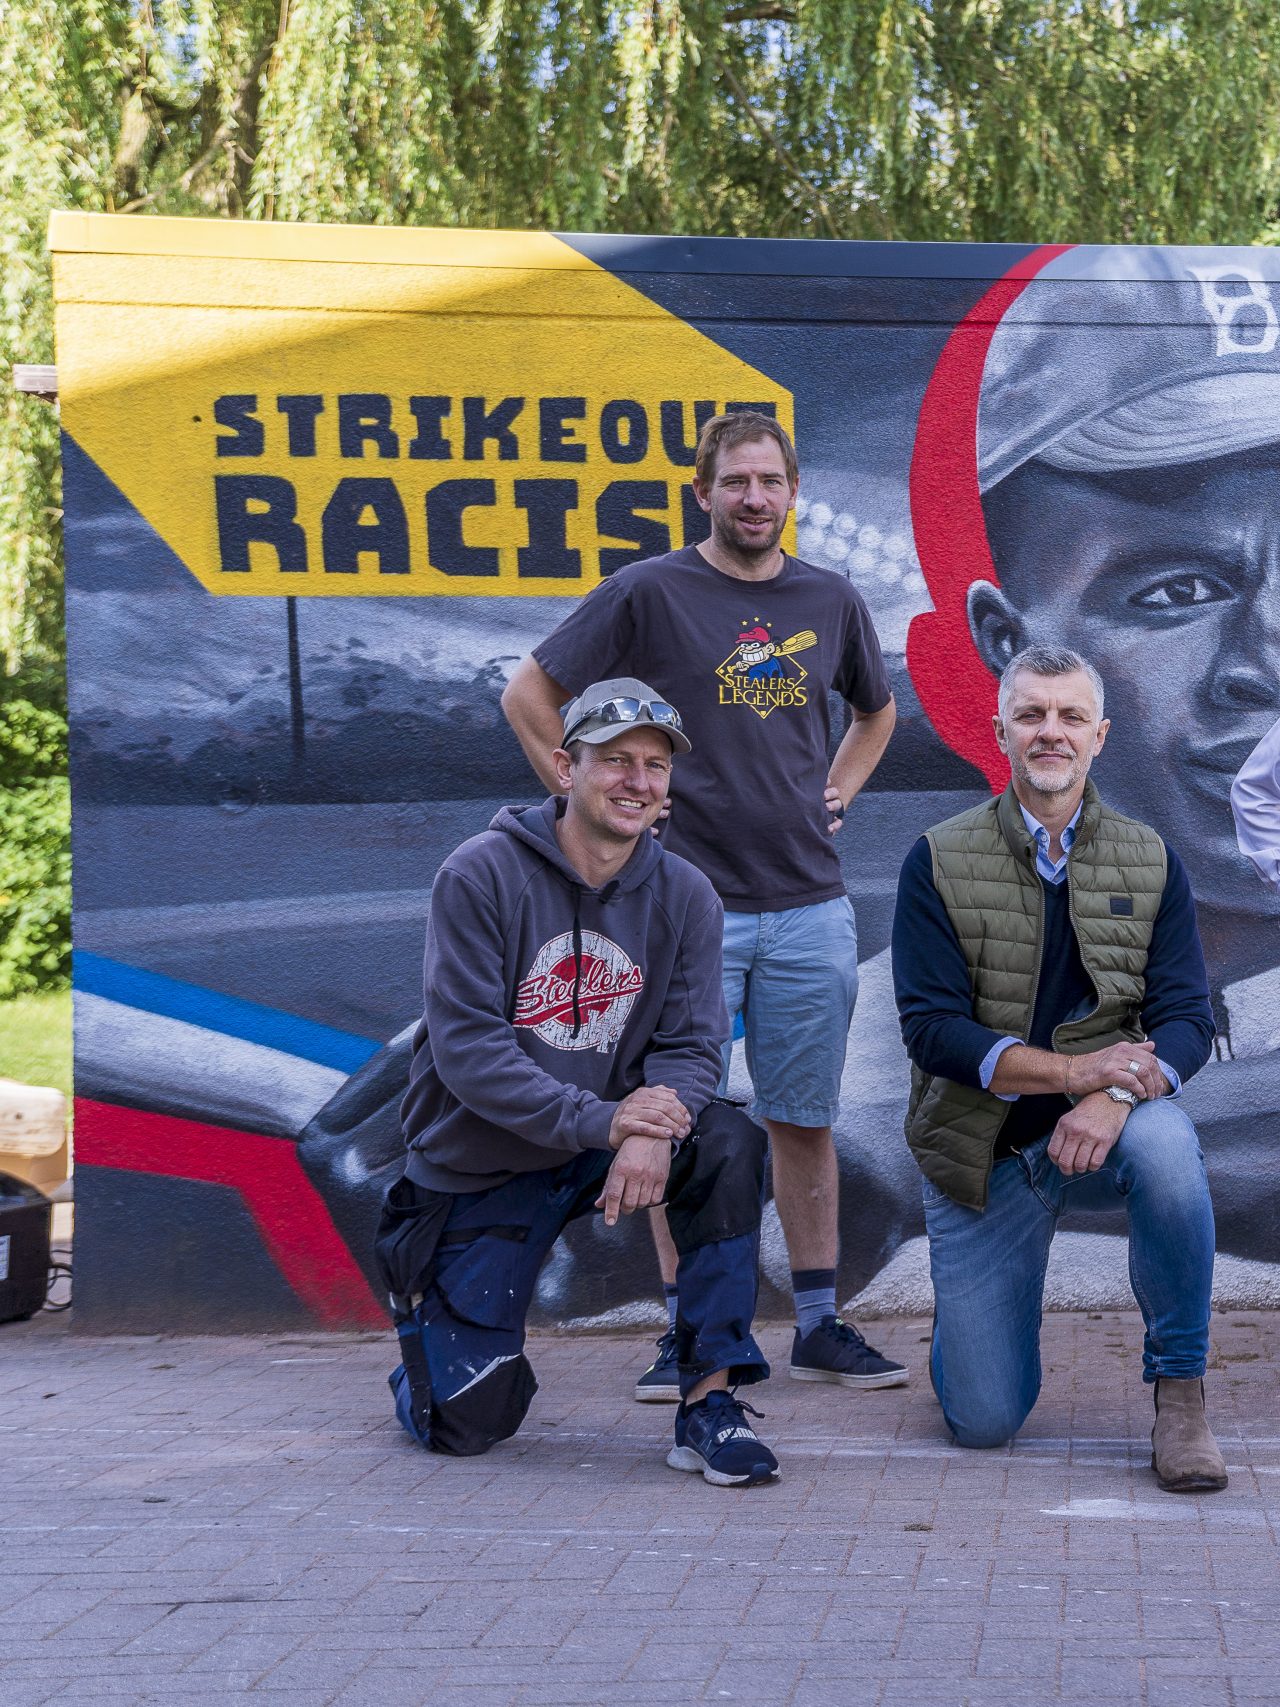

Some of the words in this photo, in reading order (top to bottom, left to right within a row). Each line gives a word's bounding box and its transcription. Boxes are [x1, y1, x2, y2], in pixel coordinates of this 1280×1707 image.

[1190, 265, 1280, 357] B
[724, 673, 796, 690] STEALERS
[719, 685, 808, 707] LEGENDS
